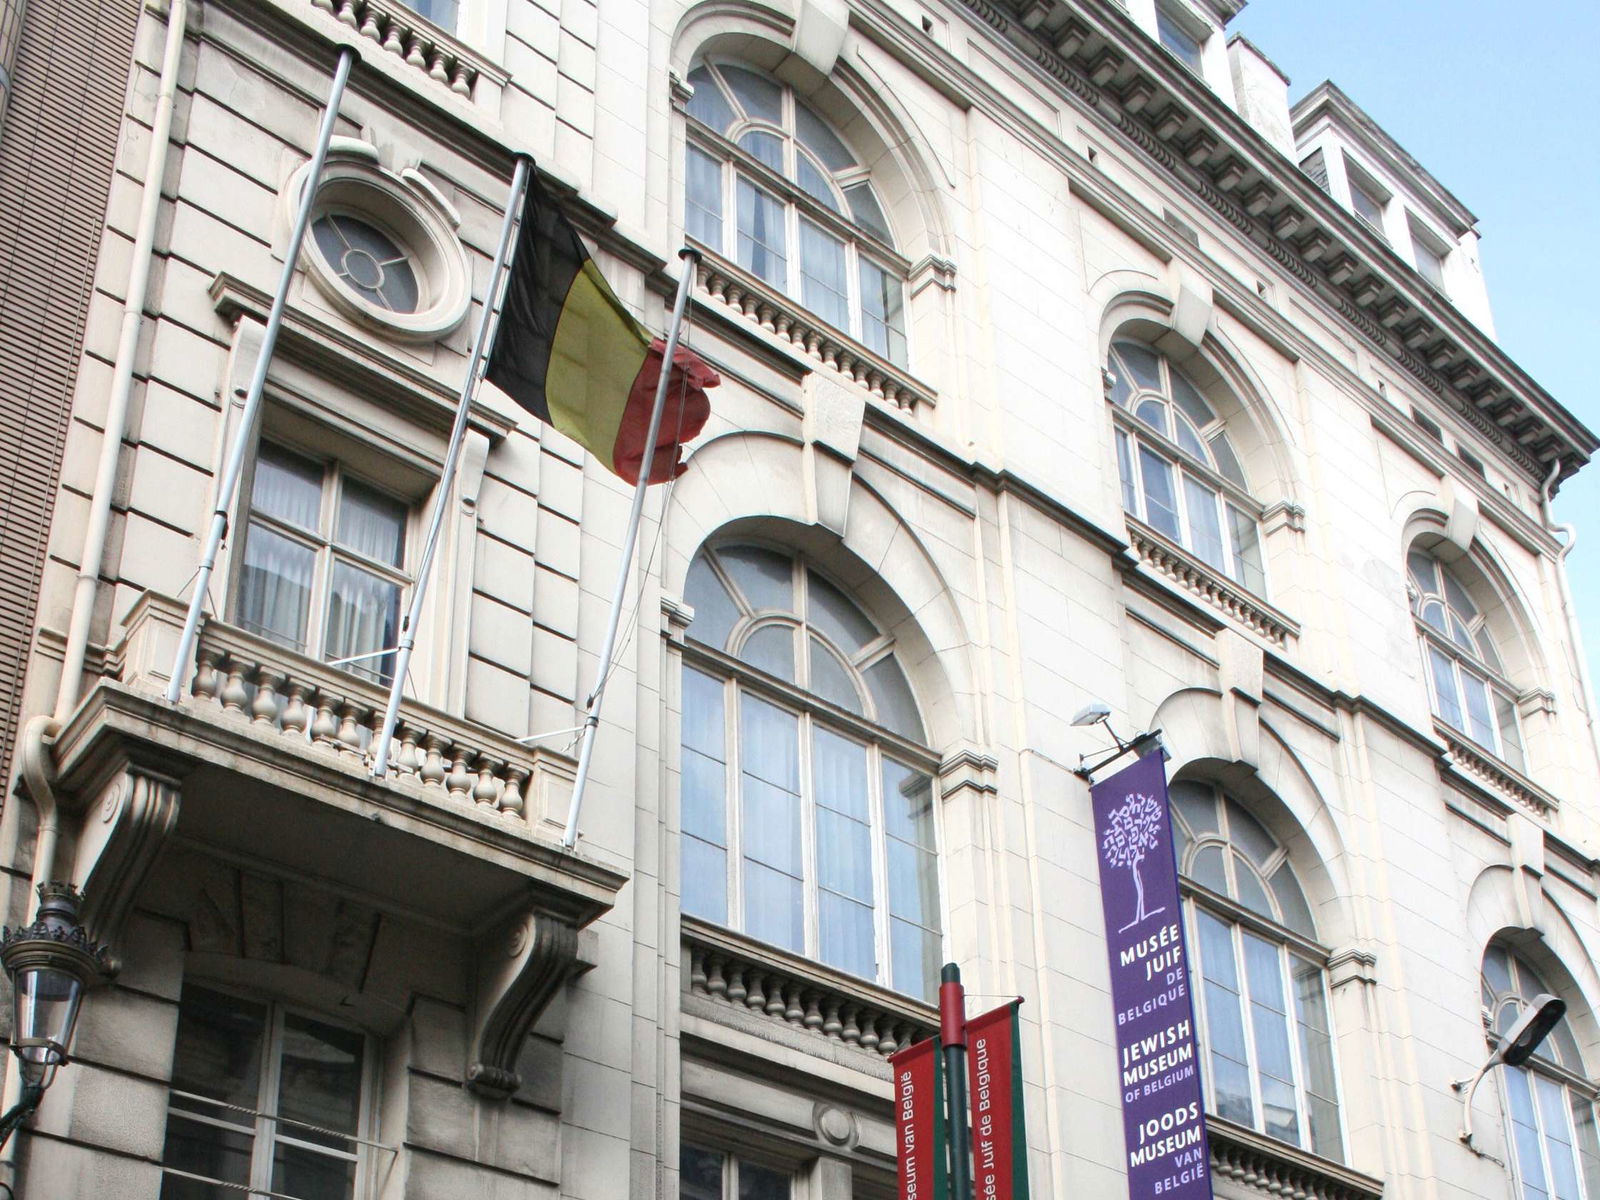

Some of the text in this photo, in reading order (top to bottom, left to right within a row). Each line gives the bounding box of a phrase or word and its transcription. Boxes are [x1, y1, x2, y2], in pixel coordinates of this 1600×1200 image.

[1120, 924, 1179, 967] MUSÉE
[1146, 946, 1181, 981] JUIF
[1166, 967, 1183, 985] DE
[1118, 984, 1185, 1026] BELGIQUE
[1123, 1019, 1190, 1068] JEWISH
[976, 1038, 991, 1112] Belgique
[1123, 1043, 1192, 1087] MUSEUM
[1125, 1065, 1194, 1103] OF BELGIUM
[900, 1071, 914, 1121] België
[904, 1123, 915, 1154] van
[979, 1114, 992, 1137] de
[1139, 1102, 1198, 1145] JOODS
[981, 1139, 995, 1169] Juif
[1130, 1125, 1201, 1168] MUSEUM
[1175, 1147, 1203, 1168] VAN
[1154, 1163, 1205, 1194] BELGIË
